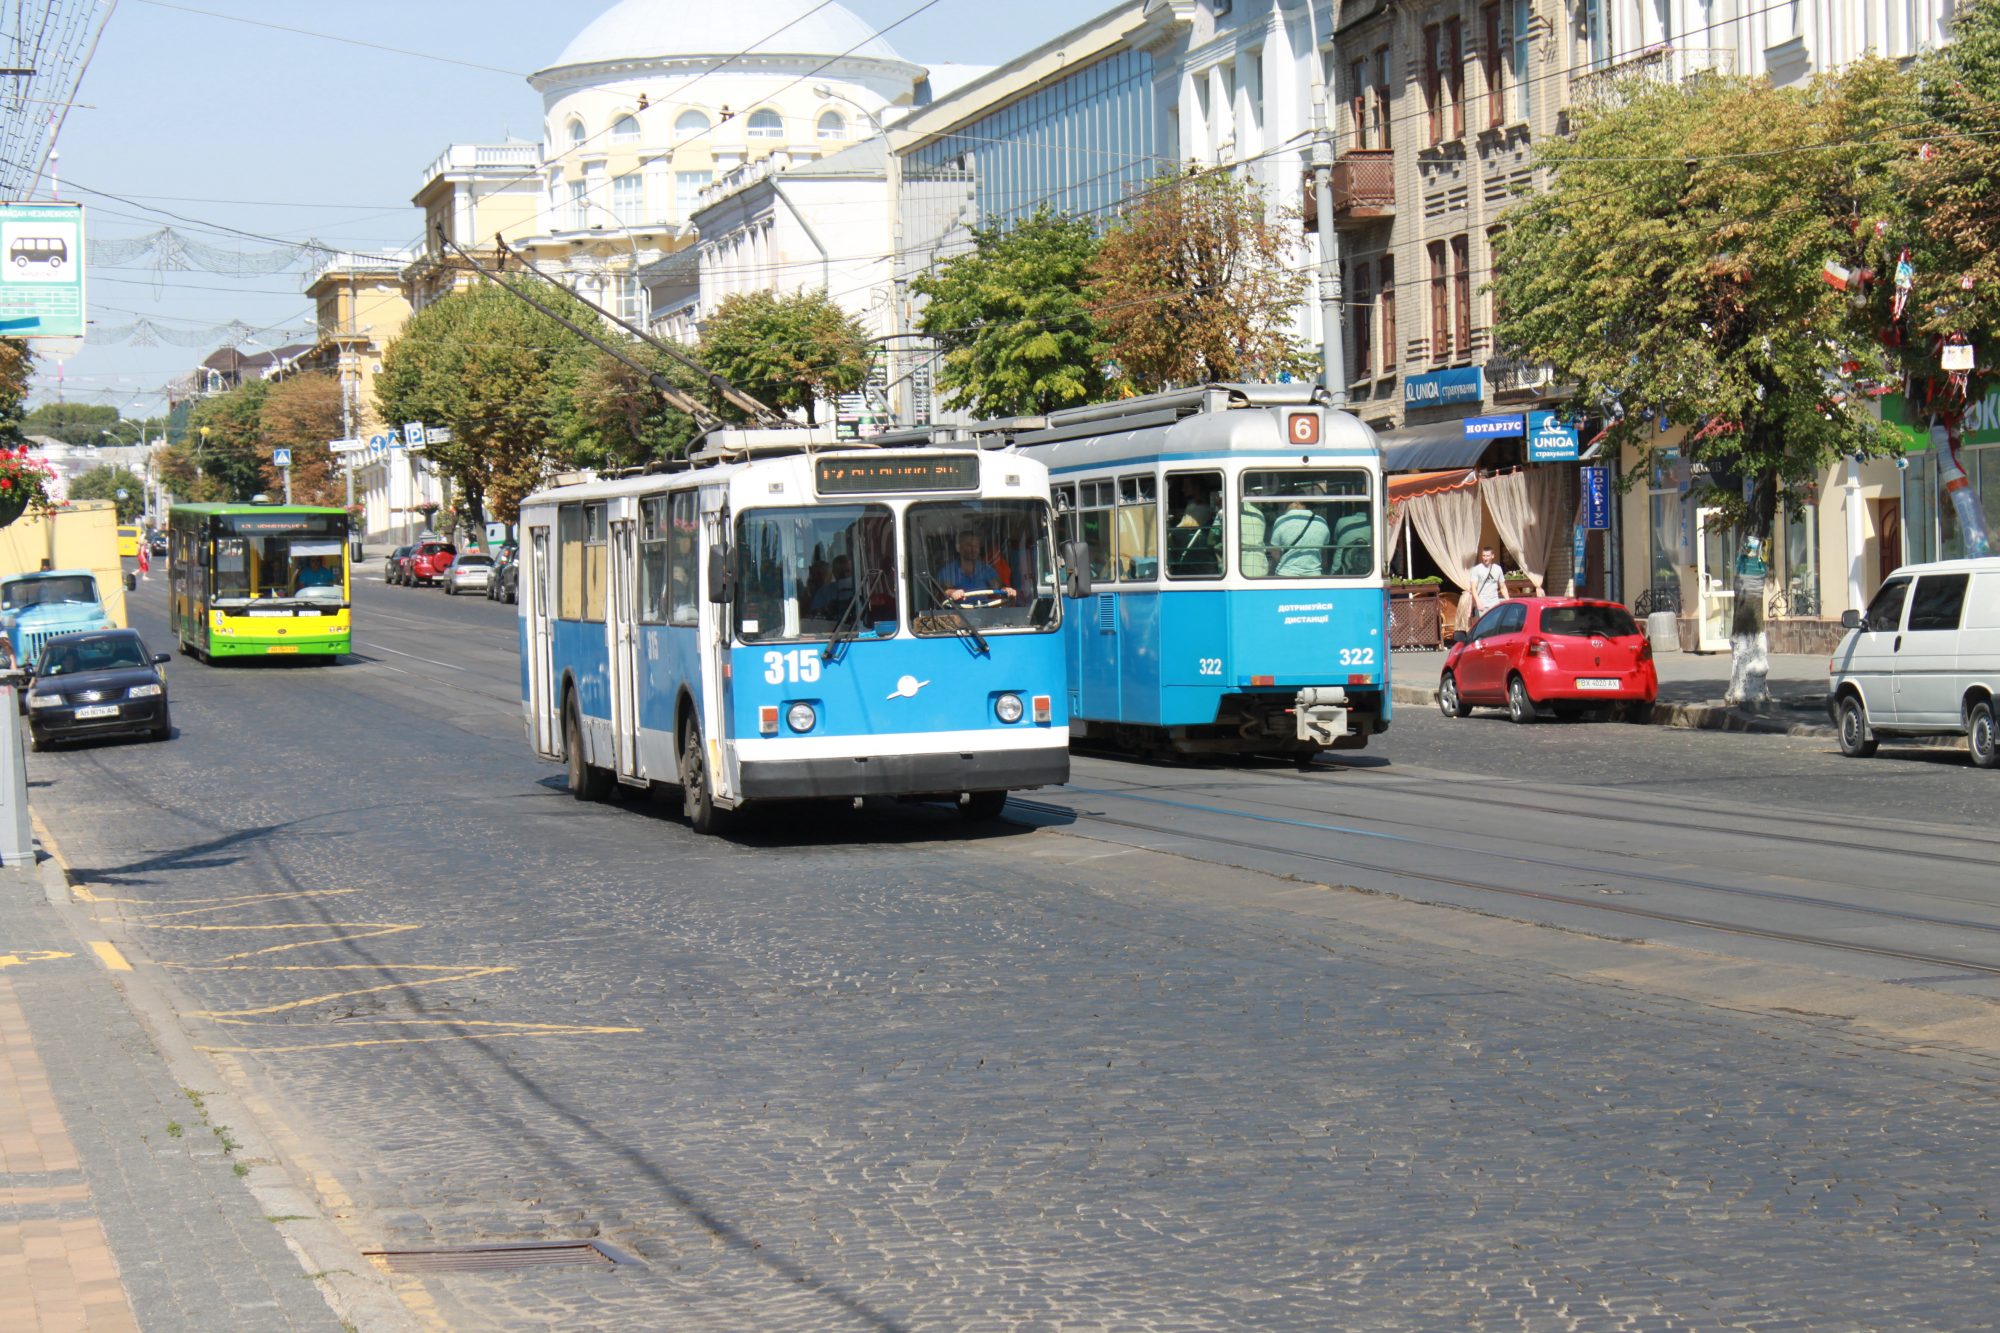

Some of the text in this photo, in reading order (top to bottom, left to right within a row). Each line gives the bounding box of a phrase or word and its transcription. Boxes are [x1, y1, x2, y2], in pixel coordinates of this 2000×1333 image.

[1416, 382, 1439, 400] UNIQA
[1442, 383, 1477, 399] страхування
[1295, 418, 1311, 439] 6
[1466, 421, 1521, 433] НОТАРІУС
[1534, 436, 1574, 448] UNIQA
[1535, 451, 1575, 459] страхування
[1593, 469, 1604, 527] НОТАРІУС
[1277, 603, 1333, 613] ДОТРИМУЙСЯ
[1284, 615, 1329, 625] ДИСТАНЦІЇ
[647, 631, 659, 660] 315
[1339, 648, 1374, 665] 322
[763, 649, 821, 685] 315
[1199, 658, 1222, 675] 322
